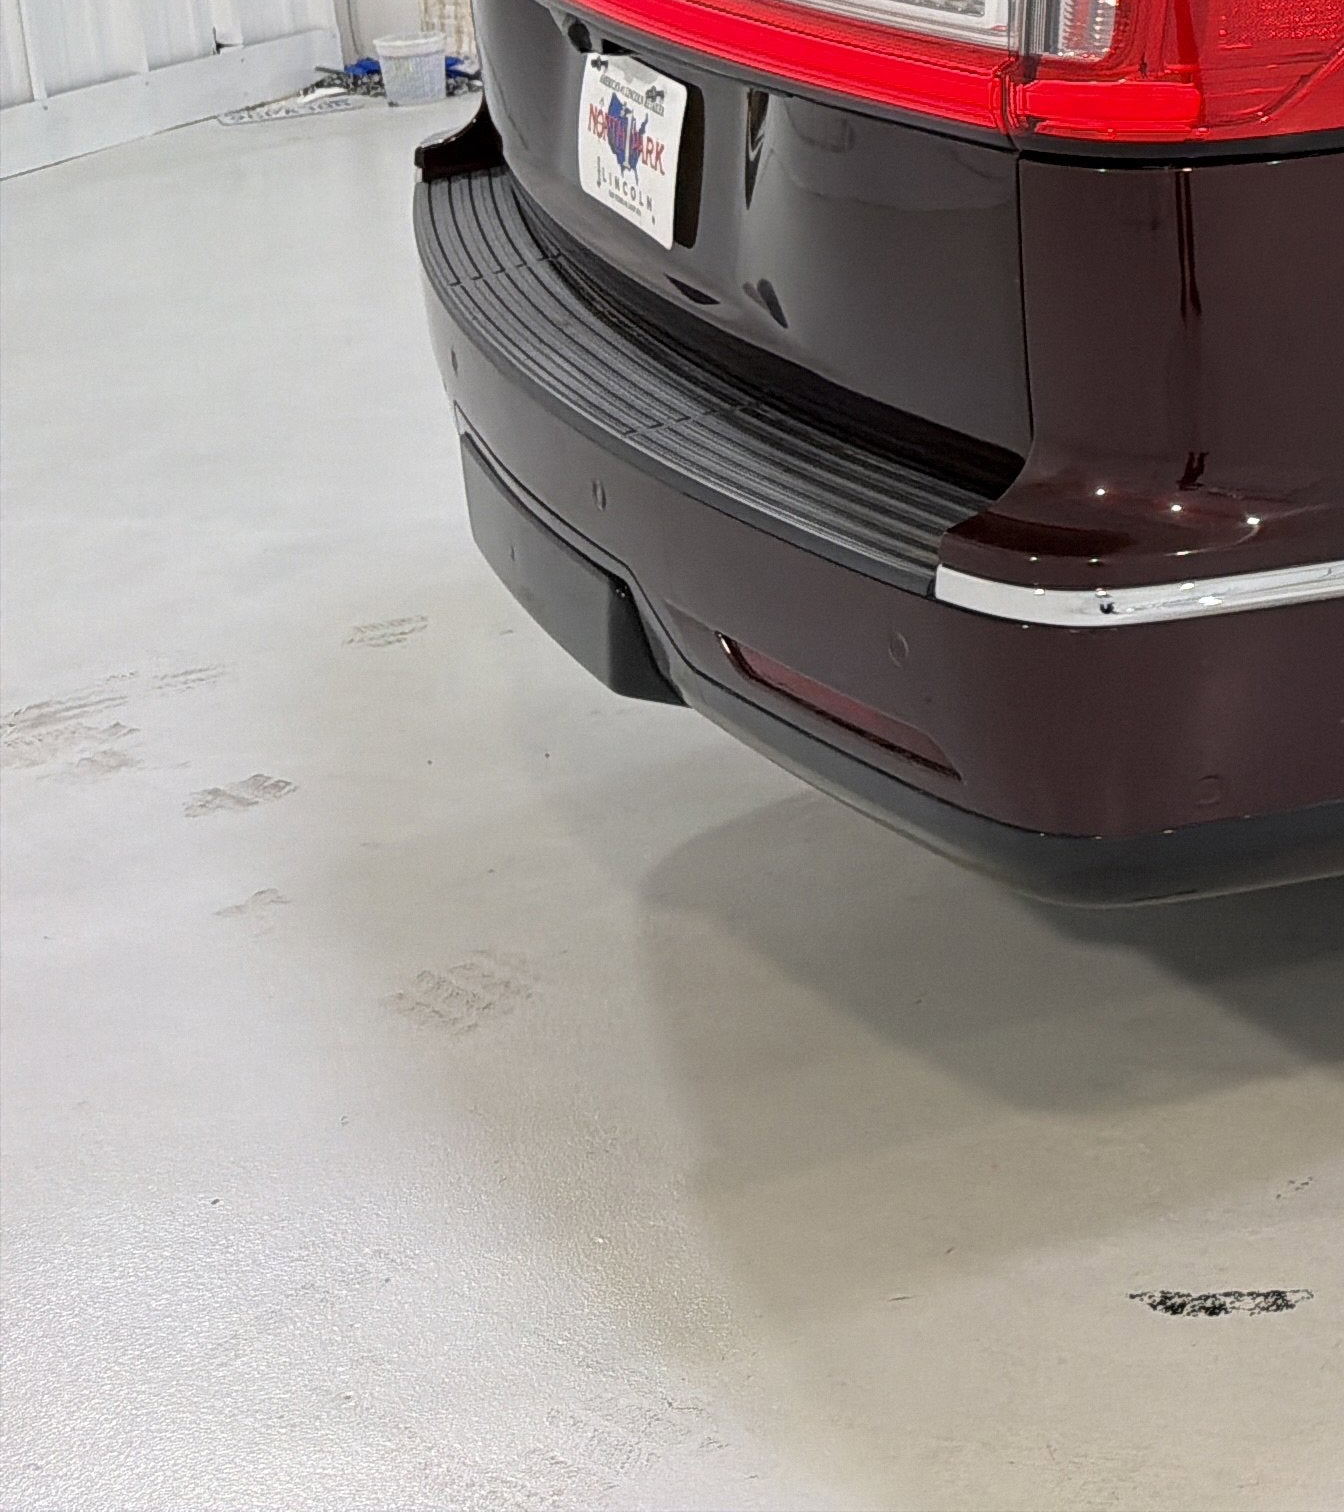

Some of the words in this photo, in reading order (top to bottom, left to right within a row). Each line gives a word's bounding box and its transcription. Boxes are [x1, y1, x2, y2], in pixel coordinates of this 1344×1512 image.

[588, 103, 627, 149] NORTH
[632, 125, 666, 176] PARK
[601, 167, 653, 212] LINCOLN
